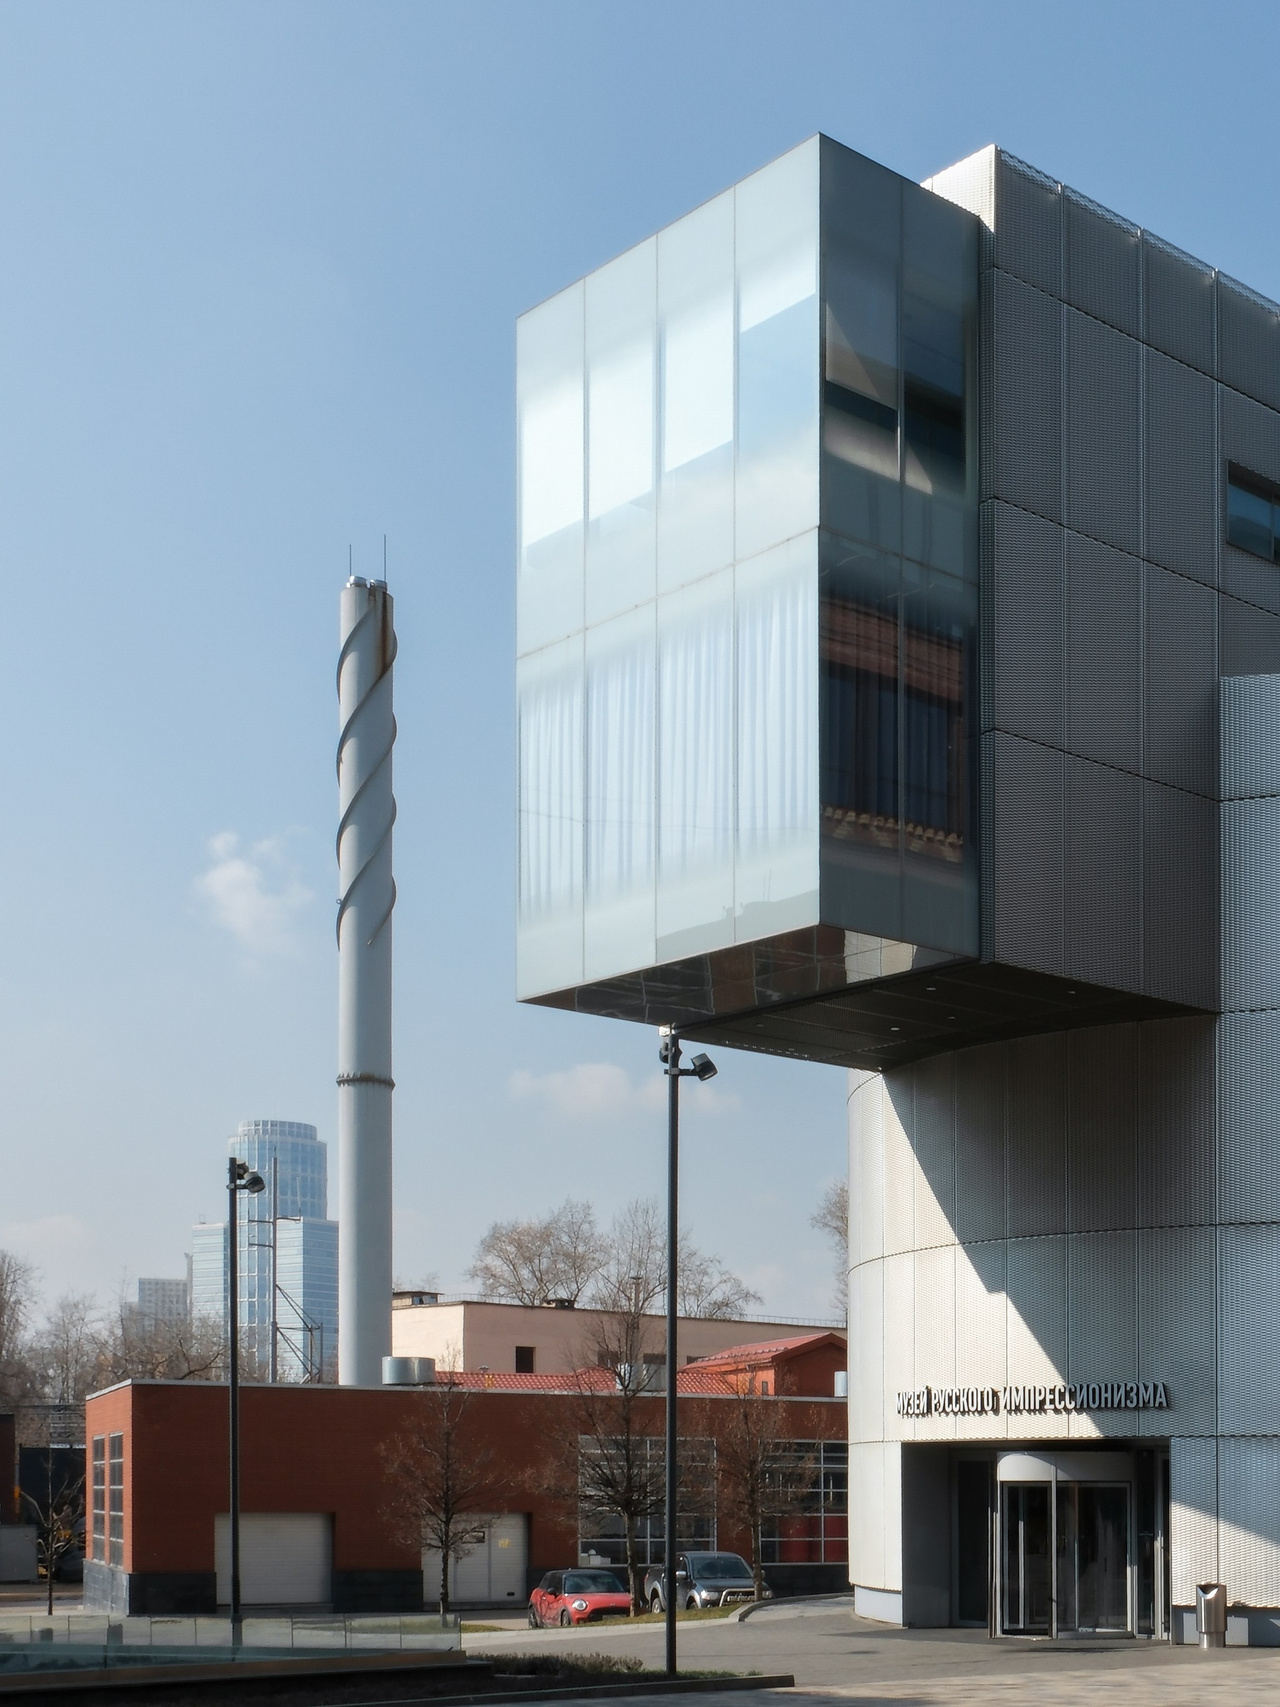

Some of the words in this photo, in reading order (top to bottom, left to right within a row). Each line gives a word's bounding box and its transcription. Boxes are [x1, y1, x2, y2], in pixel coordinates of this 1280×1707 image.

[896, 1386, 930, 1415] МУЗЕЙ
[931, 1386, 994, 1413] РУССКОГО
[1001, 1382, 1169, 1411] ИМПРЕССИОНИЗМА
